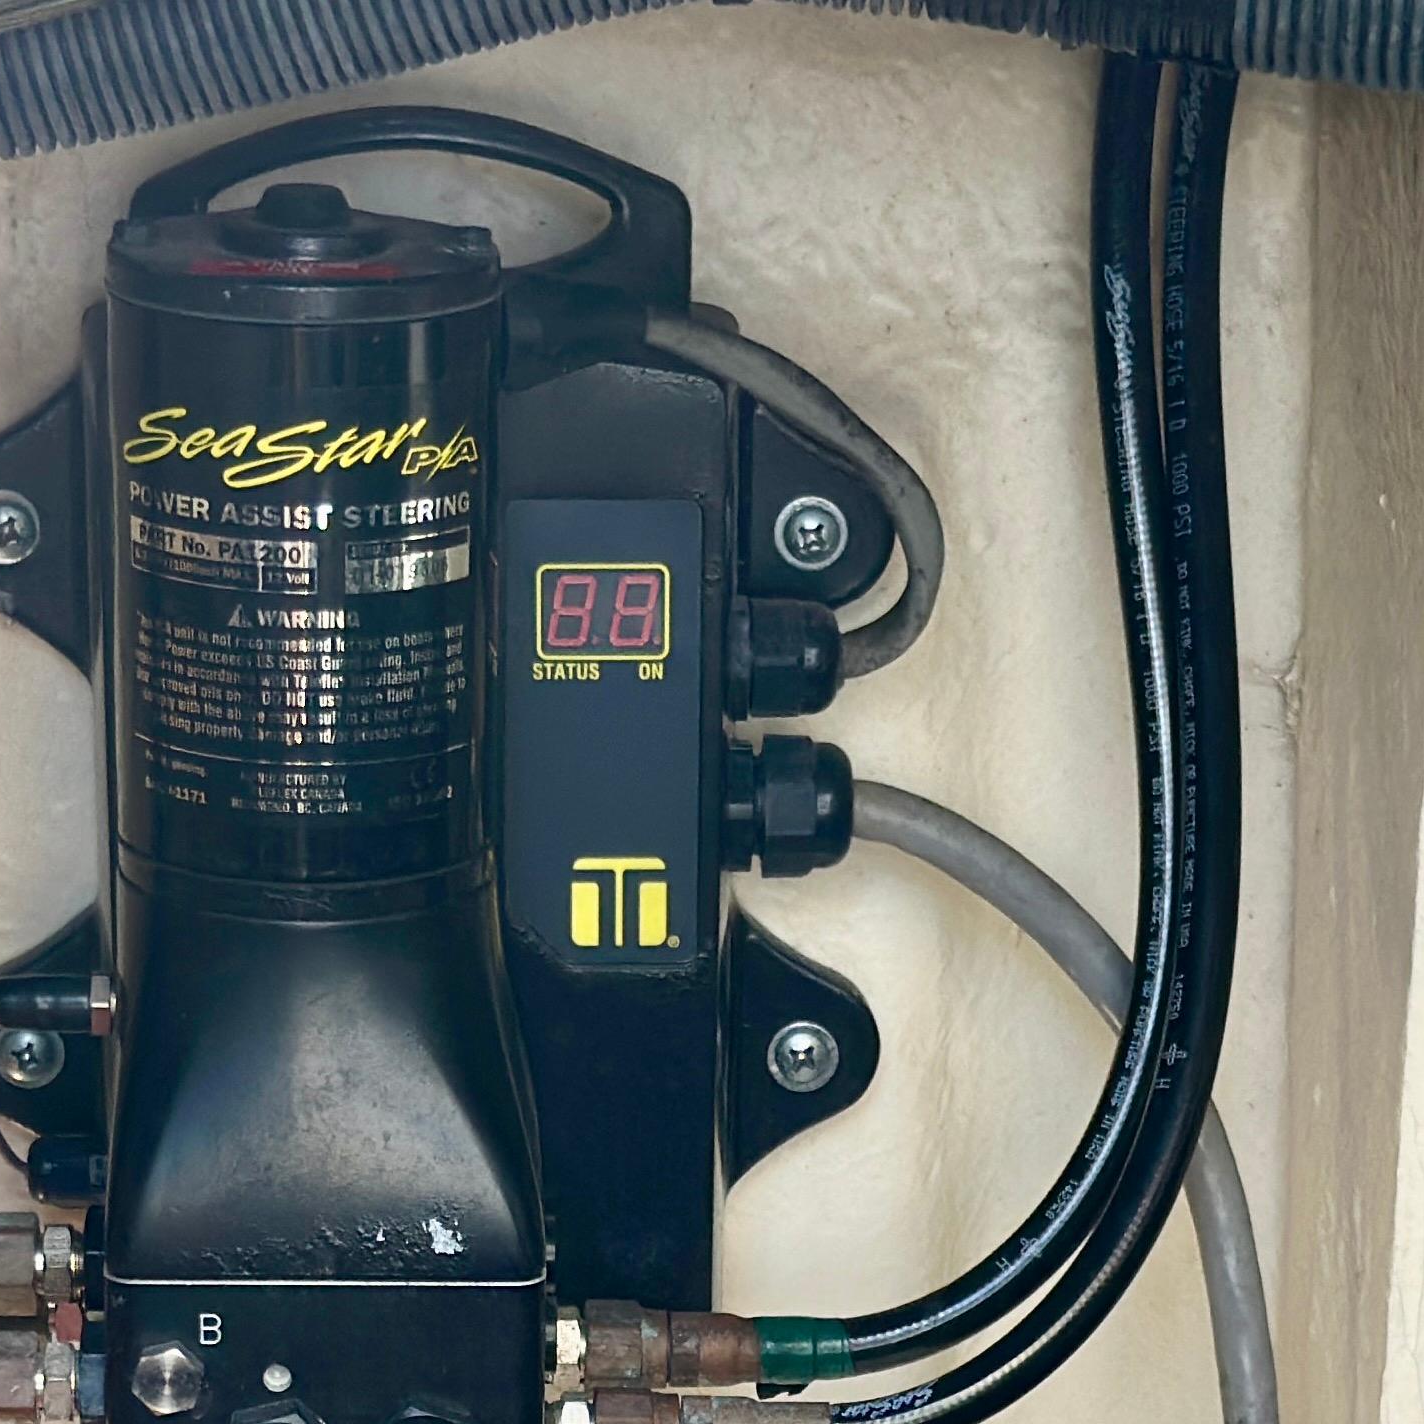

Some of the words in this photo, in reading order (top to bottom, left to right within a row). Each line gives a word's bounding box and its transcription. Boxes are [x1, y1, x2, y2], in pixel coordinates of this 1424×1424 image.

[1166, 286, 1185, 331] HOSE
[1167, 340, 1185, 386] 5/16
[1172, 453, 1188, 495] 1000
[129, 479, 210, 521] POWER
[220, 502, 334, 531] ASSIST
[342, 491, 470, 529] STEERING
[1174, 504, 1192, 537] PSI
[182, 536, 211, 557] No.
[532, 662, 600, 681] STATUS
[638, 661, 663, 681] ON
[199, 1313, 222, 1345] B
